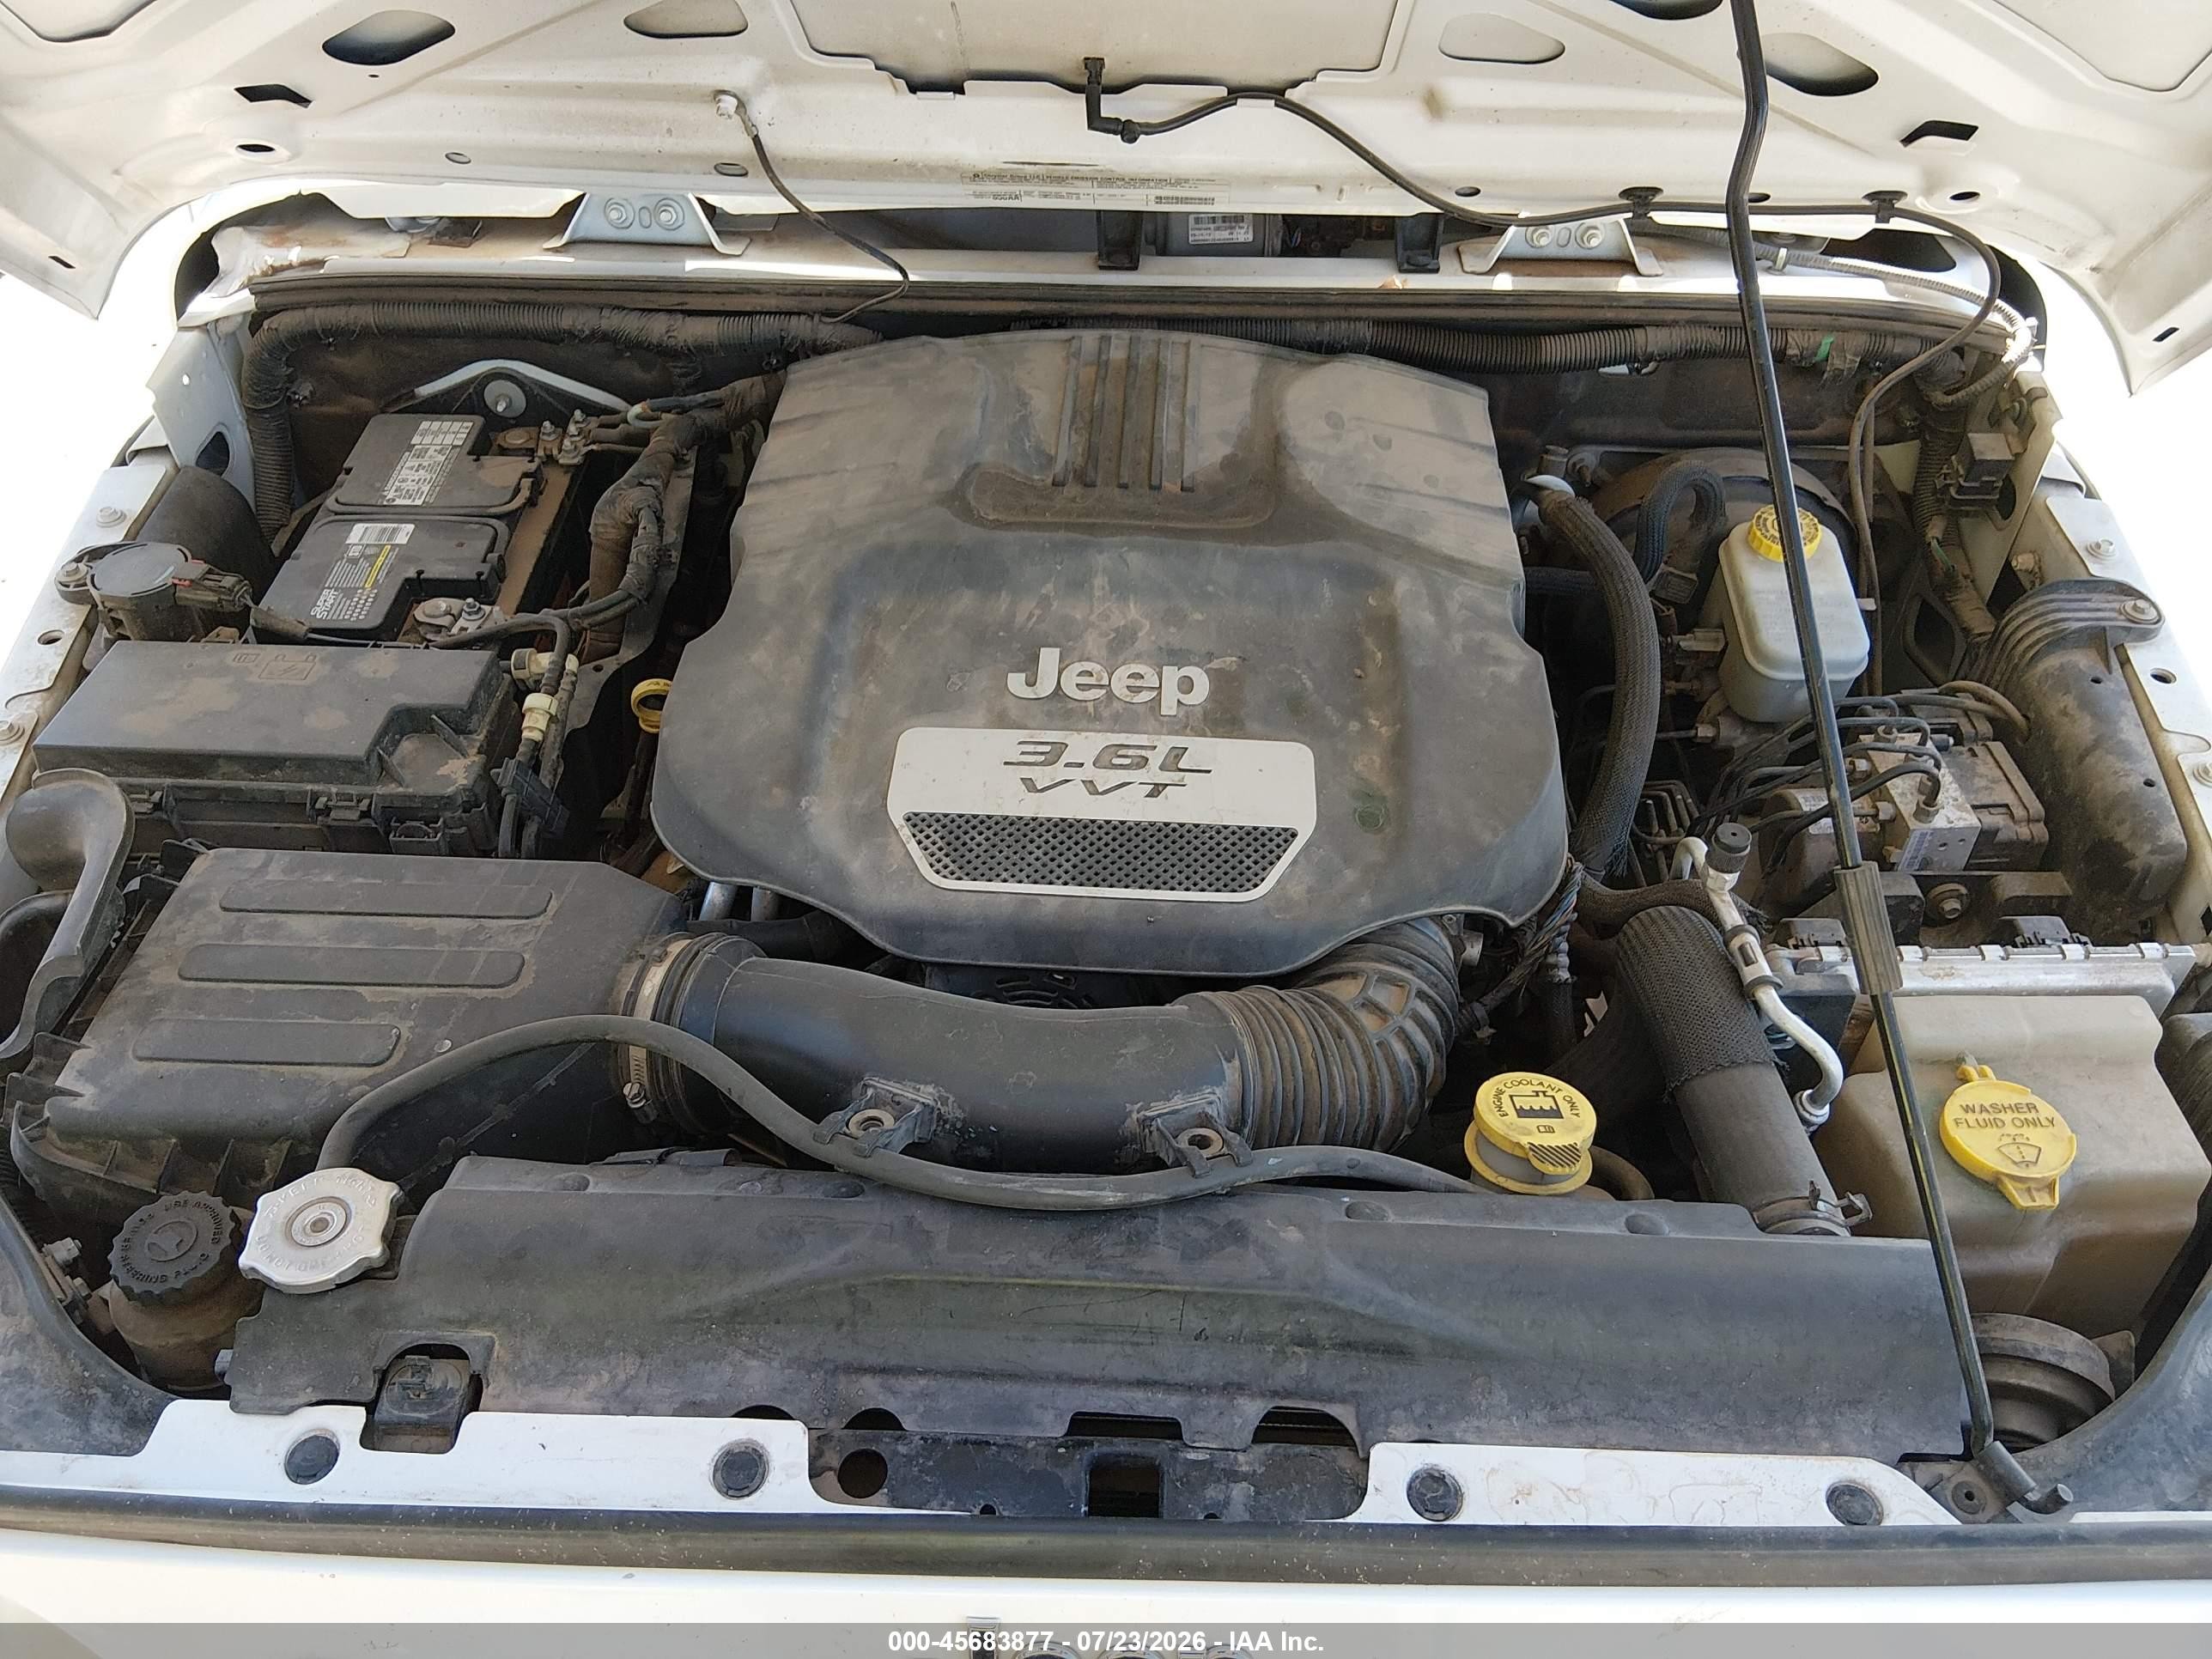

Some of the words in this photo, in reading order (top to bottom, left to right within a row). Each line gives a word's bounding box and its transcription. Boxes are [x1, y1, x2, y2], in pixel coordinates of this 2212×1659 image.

[310, 588, 331, 616] SUPER
[316, 588, 339, 619] START
[1007, 647, 1210, 716] Jeep
[1003, 740, 1212, 774] 3.6L
[1020, 777, 1188, 798] VVT
[1492, 1087, 1510, 1118] ENGINE
[1504, 1079, 1565, 1094] COOLANT
[1562, 1095, 1581, 1118] ONLY
[1960, 1102, 2039, 1114] WASHER
[1953, 1117, 2006, 1129] FLUID
[2011, 1116, 2057, 1128] ONLY
